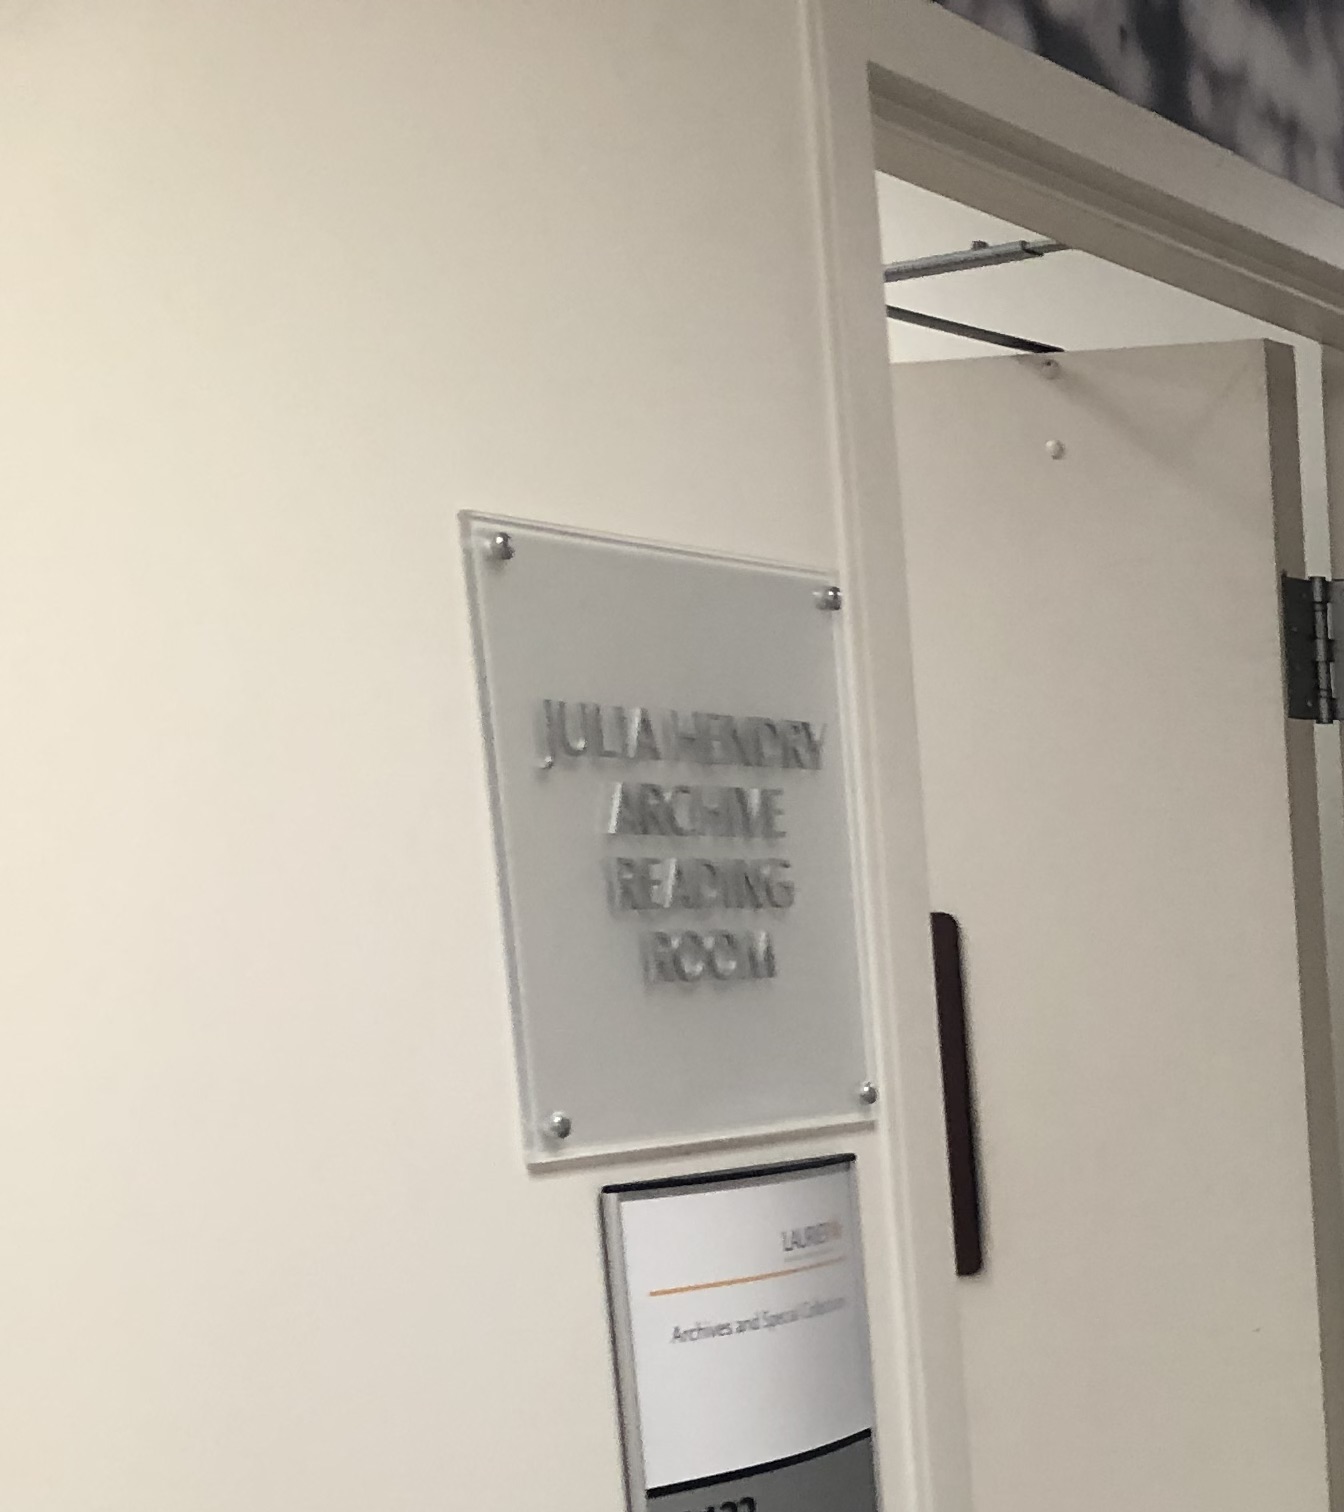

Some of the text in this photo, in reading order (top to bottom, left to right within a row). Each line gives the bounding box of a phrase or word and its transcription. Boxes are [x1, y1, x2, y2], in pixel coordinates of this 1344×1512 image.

[540, 698, 661, 770] JULIA
[606, 782, 787, 838] ARCHIVE
[606, 857, 796, 911] READING
[642, 930, 776, 983] ROOM
[670, 1320, 733, 1344] Archives
[735, 1311, 760, 1334] and
